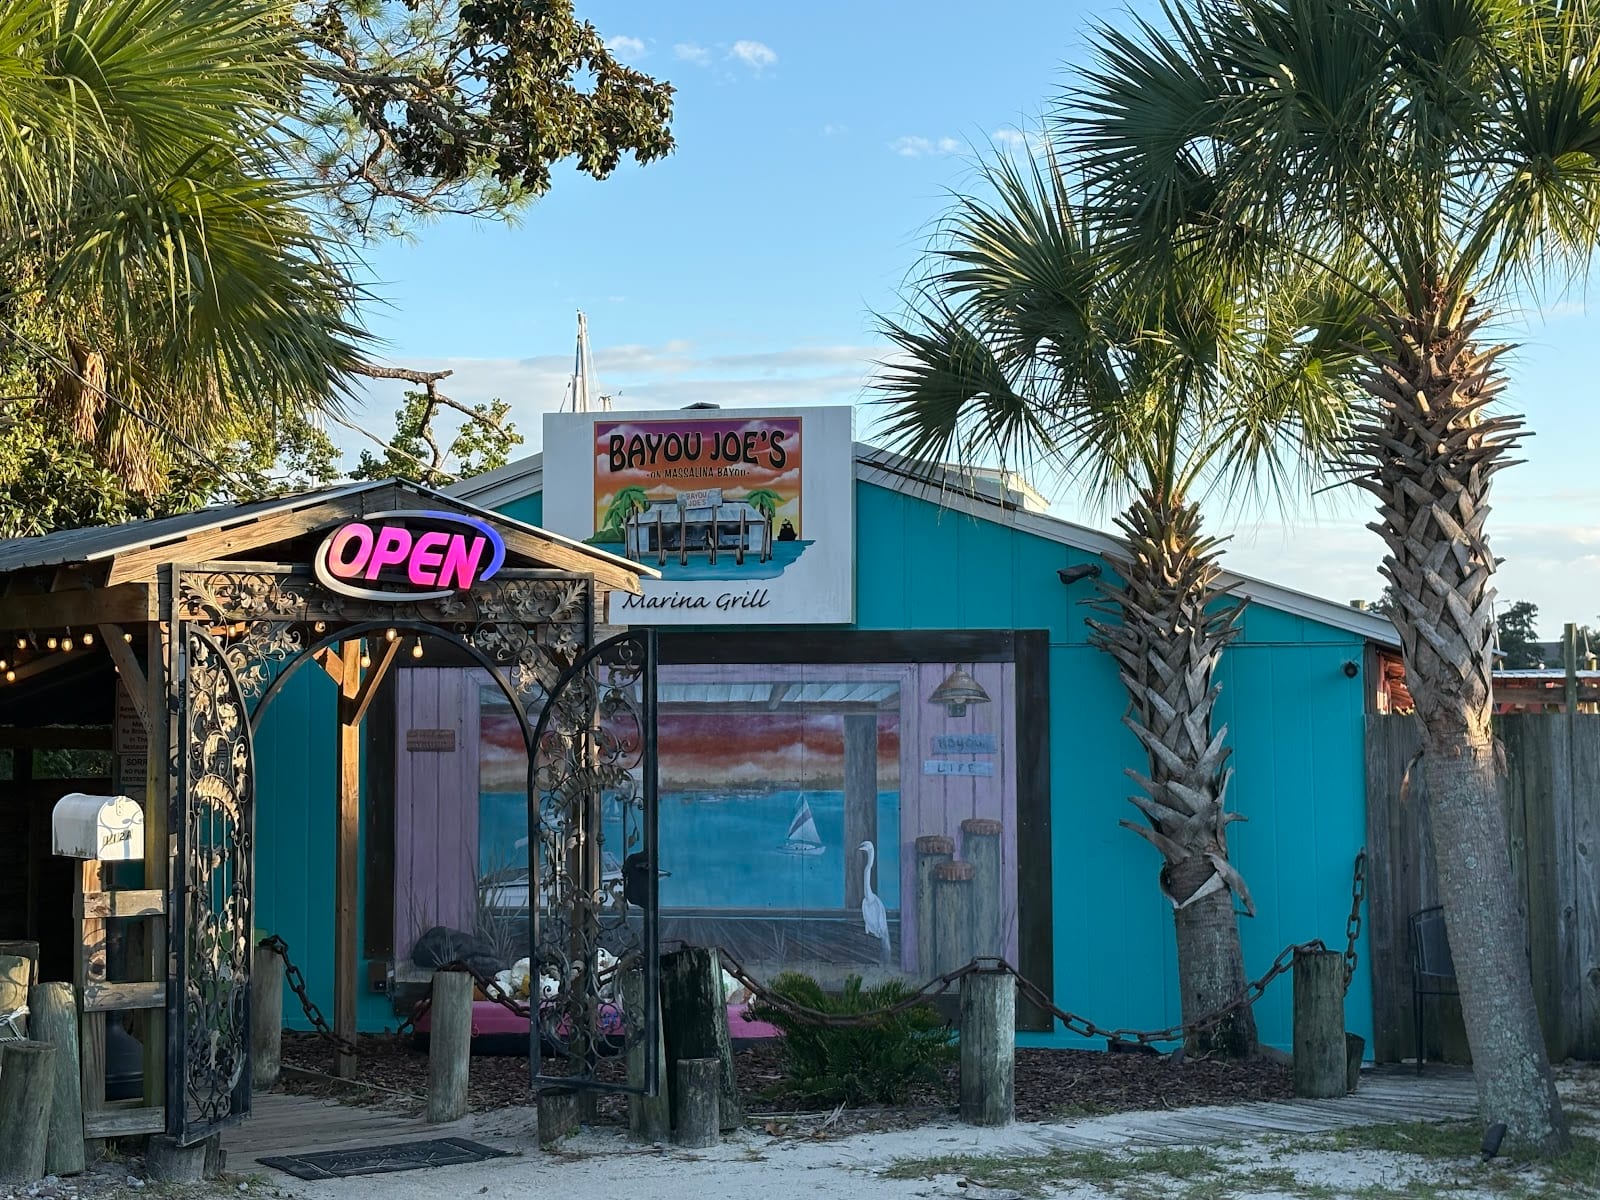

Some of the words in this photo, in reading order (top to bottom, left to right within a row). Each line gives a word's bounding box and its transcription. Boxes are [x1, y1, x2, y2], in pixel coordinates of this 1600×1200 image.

[609, 432, 701, 473] BAYOU
[710, 430, 787, 469] JOE'S
[664, 467, 714, 478] MASSALINA
[717, 467, 747, 478] BAYOU
[686, 491, 707, 500] BAYOU
[328, 523, 486, 590] OPEN
[622, 591, 711, 609] Marina
[716, 589, 770, 611] Grill
[126, 758, 148, 766] SORR
[937, 763, 975, 773] LIFE
